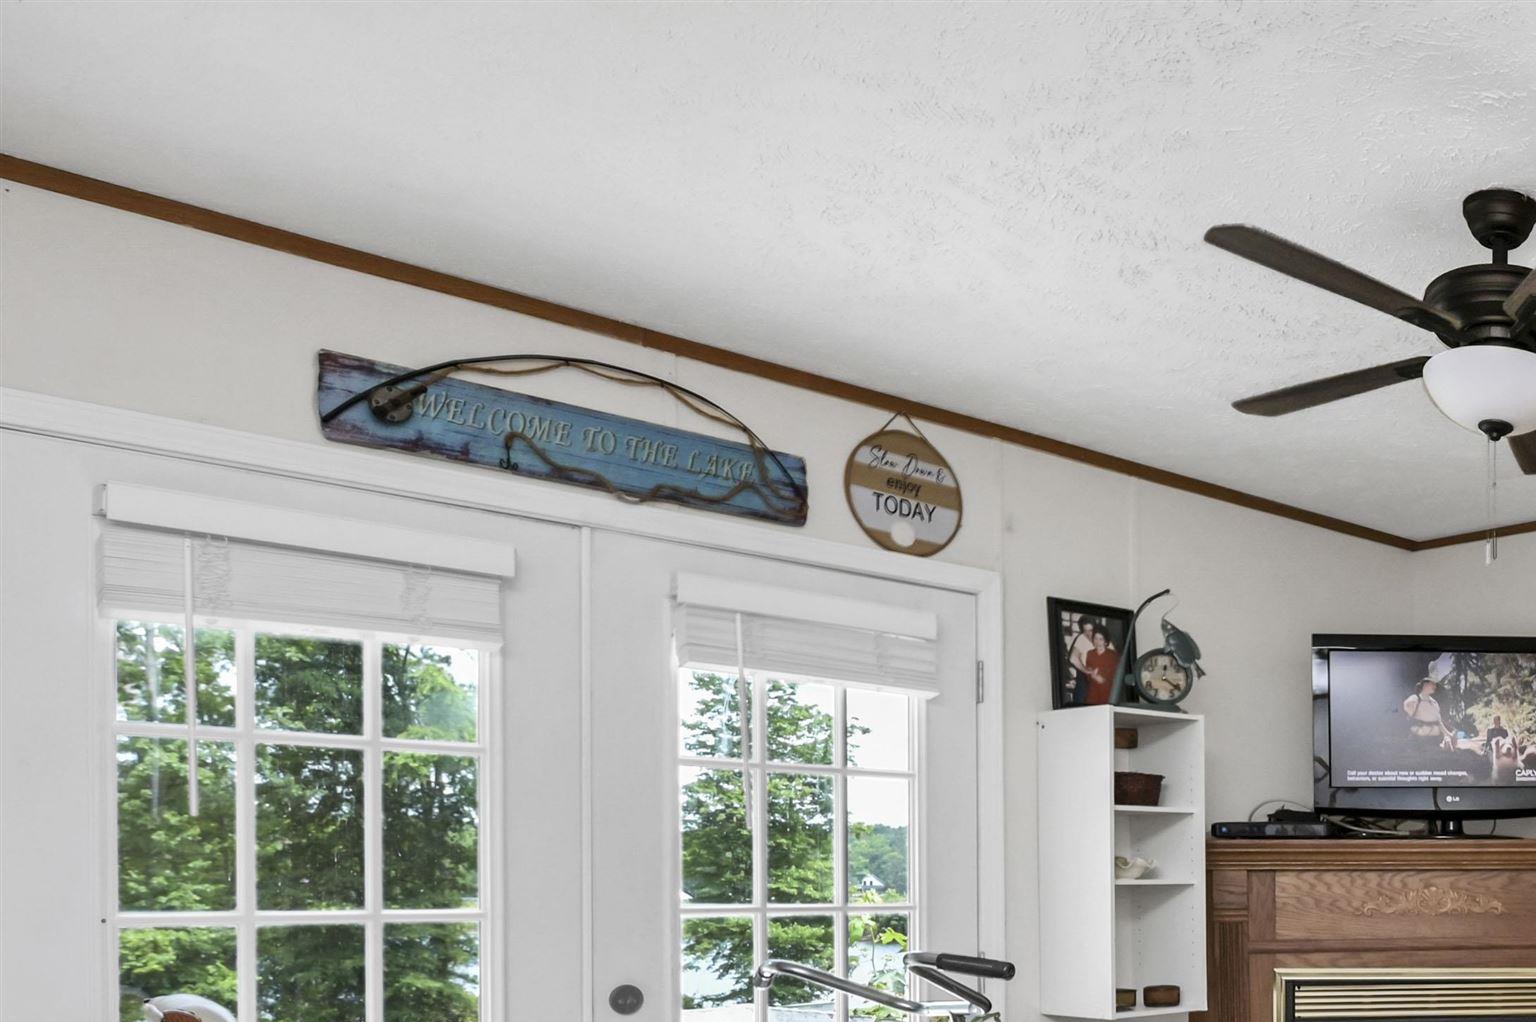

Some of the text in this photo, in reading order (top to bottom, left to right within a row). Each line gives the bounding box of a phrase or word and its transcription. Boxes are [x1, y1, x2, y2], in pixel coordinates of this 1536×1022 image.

[418, 391, 756, 481] WELCOME TO THE LAKE
[868, 444, 898, 469] Slow
[903, 453, 935, 476] Down
[886, 477, 922, 497] enjoy
[872, 491, 937, 523] TODAY
